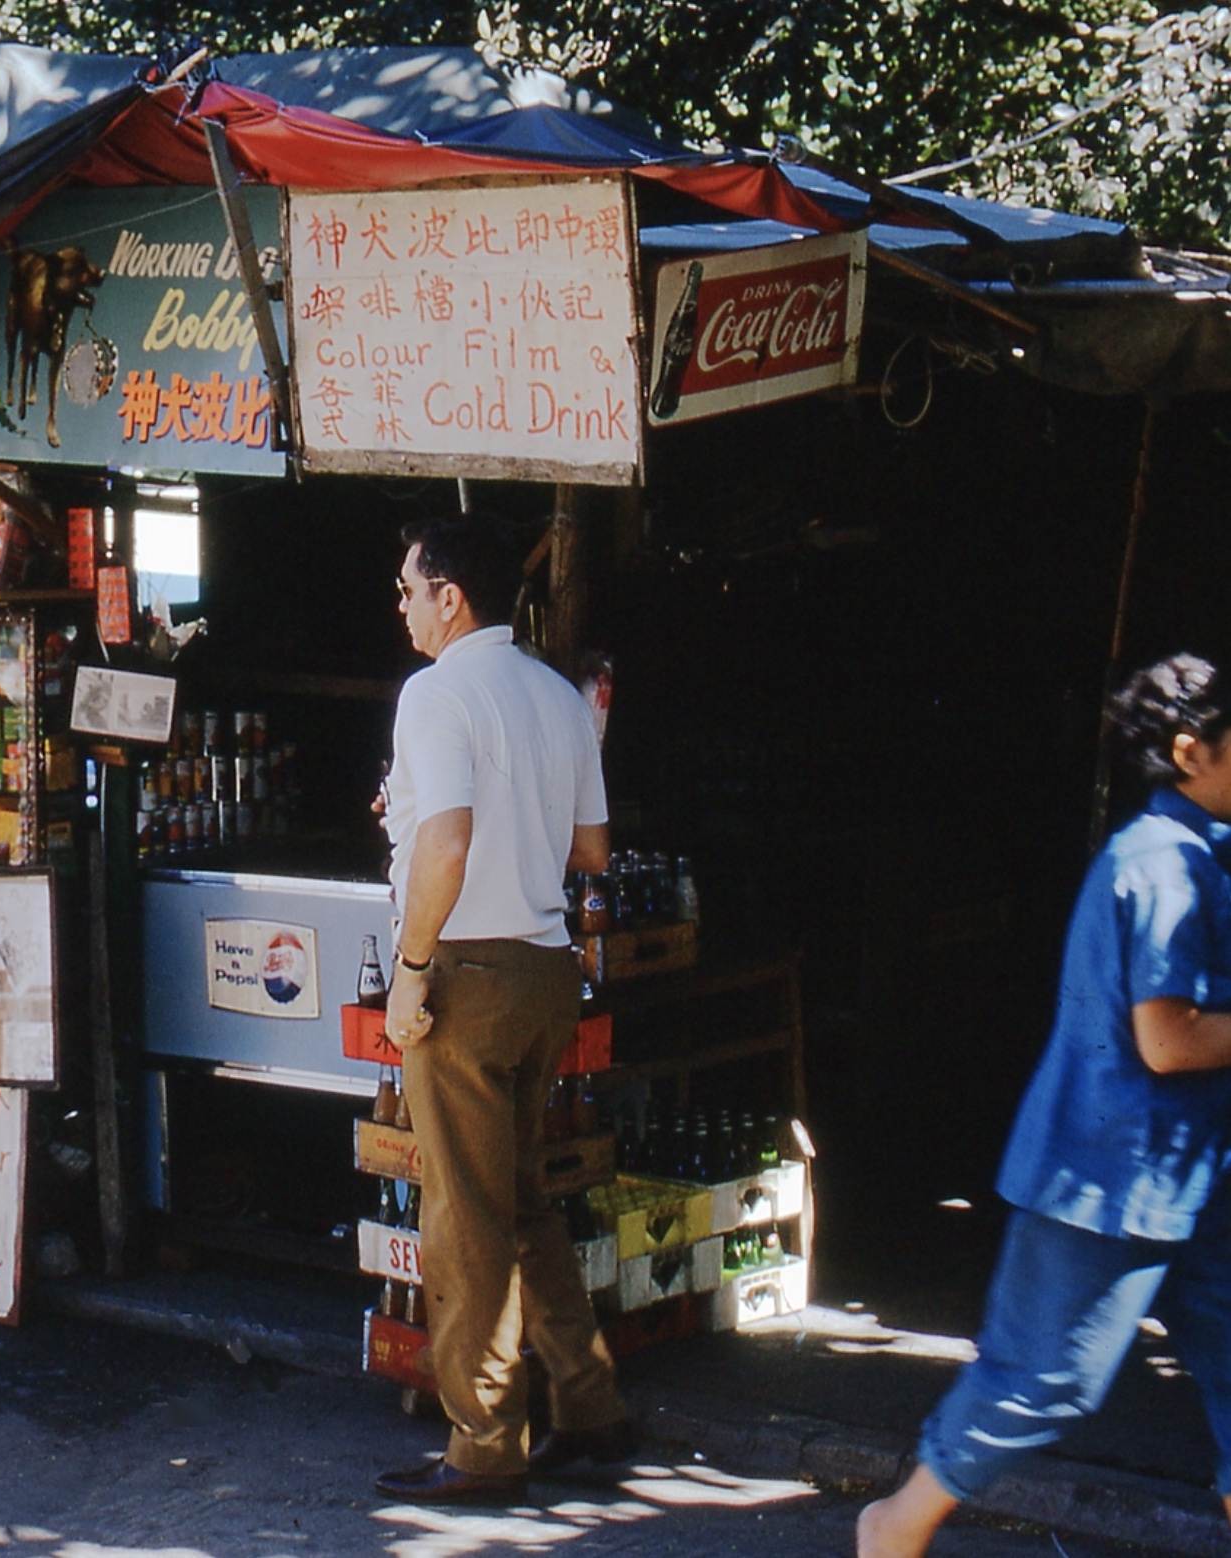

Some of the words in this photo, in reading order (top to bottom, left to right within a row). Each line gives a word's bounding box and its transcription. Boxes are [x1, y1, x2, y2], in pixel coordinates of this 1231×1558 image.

[109, 229, 214, 279] WORKING
[214, 234, 278, 281] DG
[304, 207, 624, 269] 神犬波比即中環
[741, 280, 792, 302] DRINK
[142, 288, 258, 372] Bobby
[315, 334, 433, 369] Colour
[464, 327, 562, 373] Film
[589, 346, 617, 375] &
[118, 369, 271, 448] 神犬波比
[423, 375, 513, 434] Cold
[526, 382, 630, 442] Drink
[215, 940, 254, 956] Have
[231, 960, 241, 970] a
[215, 969, 259, 986] Pepsi
